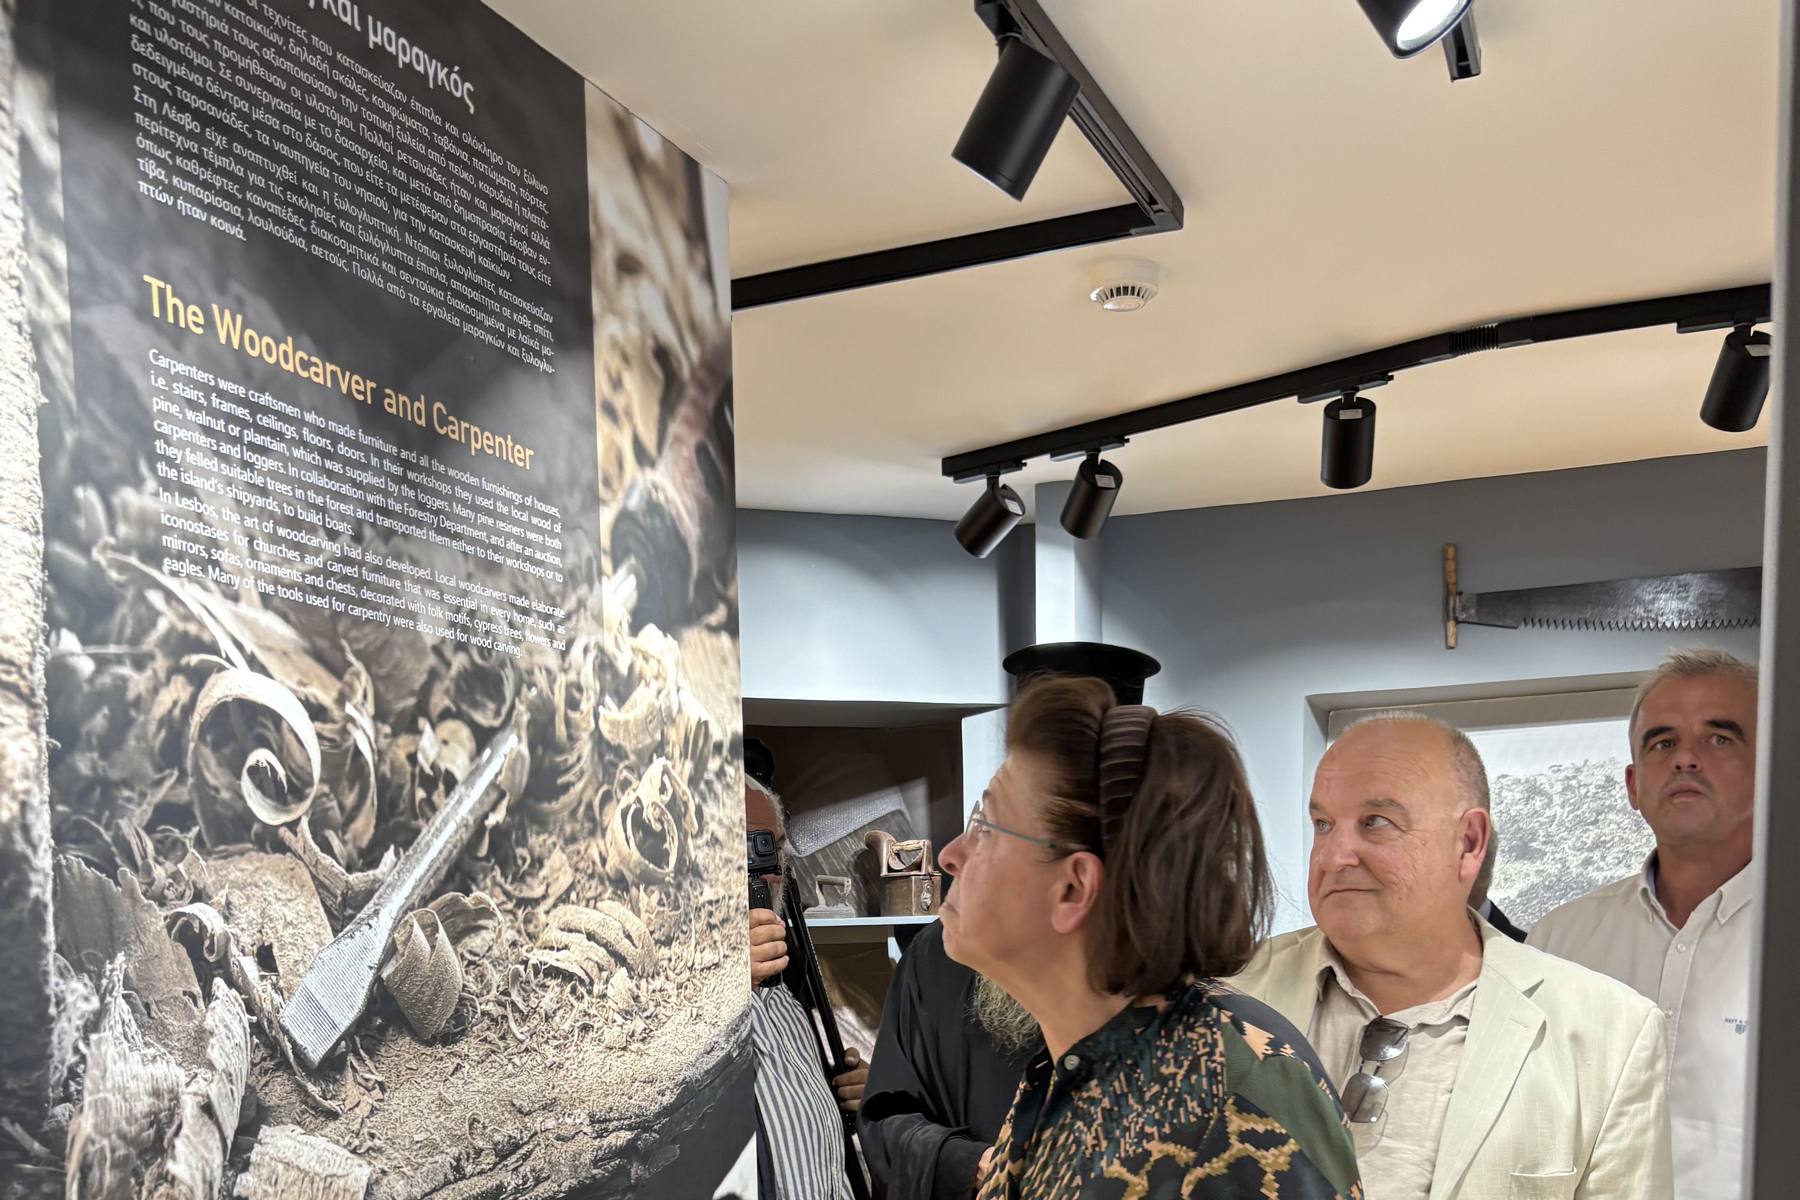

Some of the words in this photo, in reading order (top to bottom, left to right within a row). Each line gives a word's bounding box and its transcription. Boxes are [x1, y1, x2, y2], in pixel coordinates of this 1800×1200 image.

[144, 275, 205, 334] The
[211, 304, 376, 404] Woodcarver
[384, 387, 426, 427] and
[432, 402, 534, 470] Carpenter
[148, 348, 214, 386] Carpenters
[218, 377, 245, 398] were
[248, 389, 301, 419] craftsmen
[303, 410, 325, 428] who
[328, 420, 355, 439] made
[358, 428, 397, 455] furniture
[400, 448, 416, 462] and
[419, 453, 428, 467] all
[431, 457, 444, 473] the
[447, 466, 479, 486] wooden
[481, 476, 522, 504] furnishings
[524, 494, 532, 506] of
[152, 397, 182, 420] pine,
[185, 409, 225, 432] walnut
[228, 424, 240, 438] or
[243, 428, 289, 457] plantain,
[291, 446, 321, 466] which
[324, 458, 343, 473] was
[345, 465, 383, 488] supplied
[387, 477, 398, 496] by
[401, 482, 415, 498] the
[417, 487, 450, 511] loggers.
[453, 501, 474, 523] Many
[477, 512, 493, 526] pine
[526, 529, 543, 543] were
[544, 533, 561, 549] both
[153, 419, 217, 450] carpenters
[219, 441, 240, 458] and
[243, 446, 286, 473] loggers.
[288, 462, 298, 478] In
[300, 469, 364, 500] collaboration
[366, 491, 385, 507] with
[387, 496, 401, 512] the
[403, 502, 437, 528] Forestry
[439, 514, 488, 544] Department,
[490, 534, 504, 546] and
[506, 538, 522, 553] after
[524, 545, 532, 556] an
[155, 439, 183, 465] they
[185, 448, 218, 472] felled
[220, 463, 264, 487] suitable
[266, 476, 292, 496] trees
[295, 485, 304, 500] in
[307, 489, 323, 506] the
[325, 494, 353, 515] forest
[355, 507, 373, 522] and
[376, 512, 426, 539] transported
[429, 529, 450, 546] them
[452, 539, 474, 554] either
[477, 545, 485, 557] to
[487, 548, 504, 564] their
[506, 556, 544, 578] workshops
[546, 569, 553, 579] or
[555, 571, 562, 582] to
[156, 461, 178, 481] the
[226, 484, 280, 515] shipyards,
[283, 502, 294, 516] to
[297, 504, 322, 525] build
[325, 513, 354, 535] boats.
[172, 382, 207, 407] stairs,
[211, 392, 252, 424] frames,
[256, 413, 298, 441] ceilings,
[302, 426, 333, 453] floors,
[337, 439, 367, 463] doors.
[370, 453, 379, 467] In
[382, 457, 403, 476] their
[406, 468, 451, 495] workshops
[454, 484, 472, 504] they
[474, 494, 493, 508] used
[496, 499, 508, 514] the
[511, 504, 528, 521] local
[531, 514, 551, 529] wood
[553, 522, 561, 533] of
[159, 487, 171, 504] In
[175, 492, 217, 520] Lesbos,
[222, 506, 240, 524] the
[243, 515, 259, 529] art
[262, 519, 273, 534] of
[276, 525, 340, 556] woodcarving
[343, 541, 361, 559] had
[364, 549, 382, 565] also
[385, 554, 432, 579] developed.
[435, 569, 455, 586] Local
[458, 579, 506, 601] woodcarvers
[508, 593, 529, 607] made
[531, 598, 564, 617] elaborate
[163, 557, 205, 578] eagles.
[207, 566, 239, 590] Many
[242, 575, 254, 590] of
[257, 578, 274, 595] the
[277, 584, 303, 602] tools
[305, 593, 329, 608] used
[331, 596, 345, 612] for
[347, 604, 390, 627] carpentry
[393, 615, 413, 629] were
[415, 619, 432, 634] also
[435, 626, 454, 639] used
[456, 628, 467, 642] for
[470, 635, 491, 648] wood
[493, 641, 521, 658] carving.
